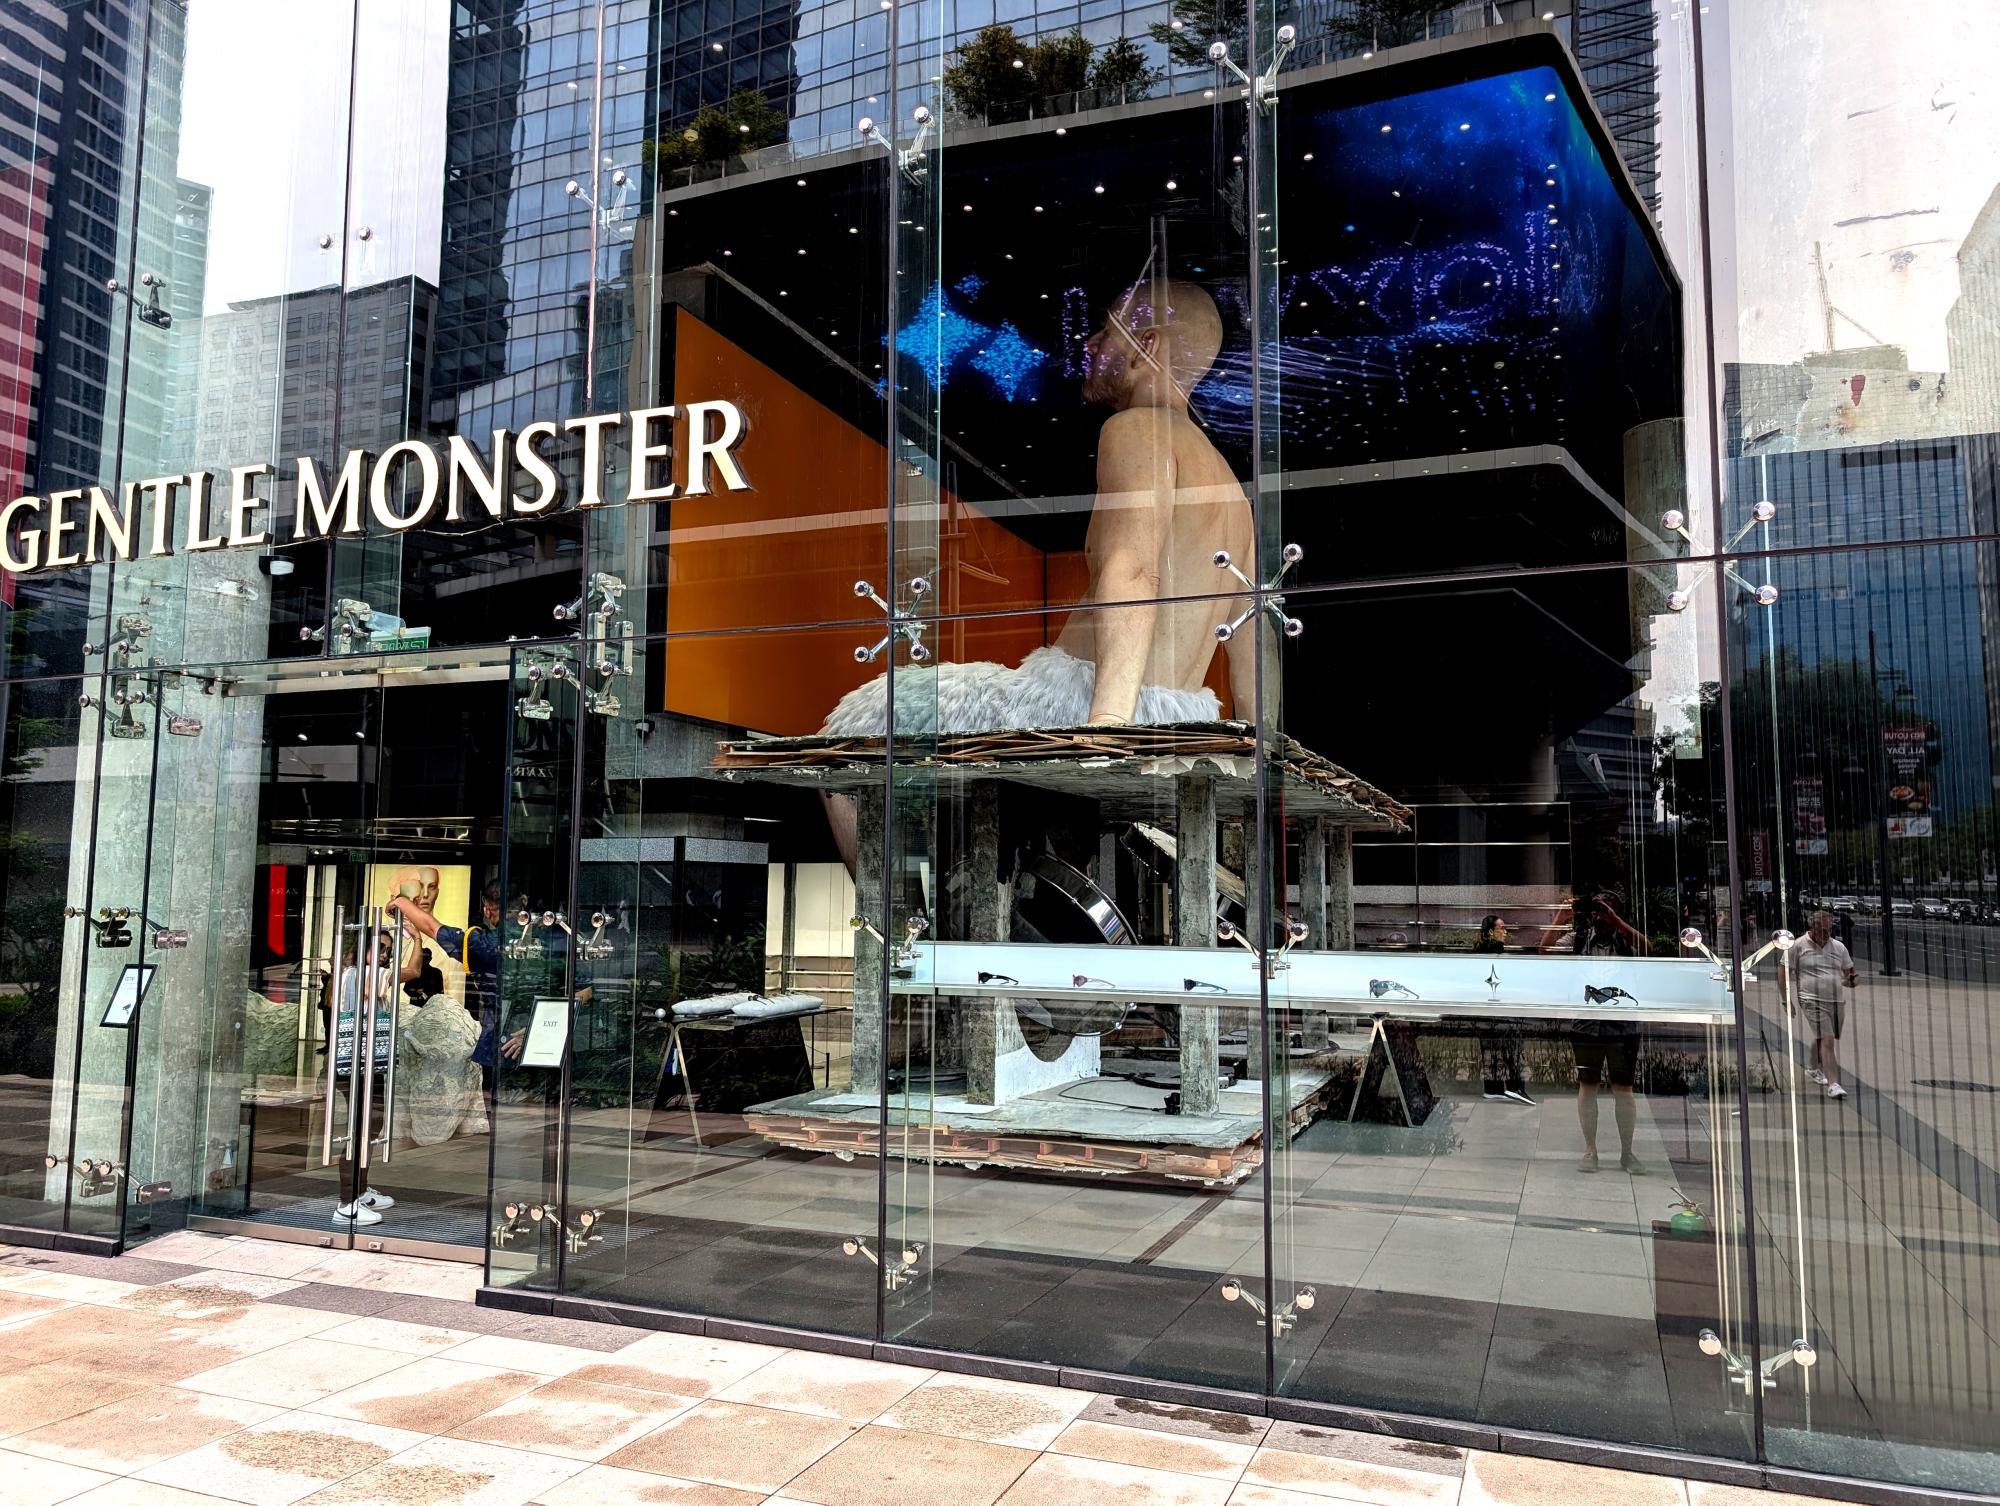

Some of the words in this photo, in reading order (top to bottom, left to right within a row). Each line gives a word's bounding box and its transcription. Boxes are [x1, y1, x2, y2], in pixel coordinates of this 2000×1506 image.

[0, 463, 275, 573] GENTLE
[293, 400, 753, 538] MONSTER
[542, 1020, 559, 1029] EXIT
